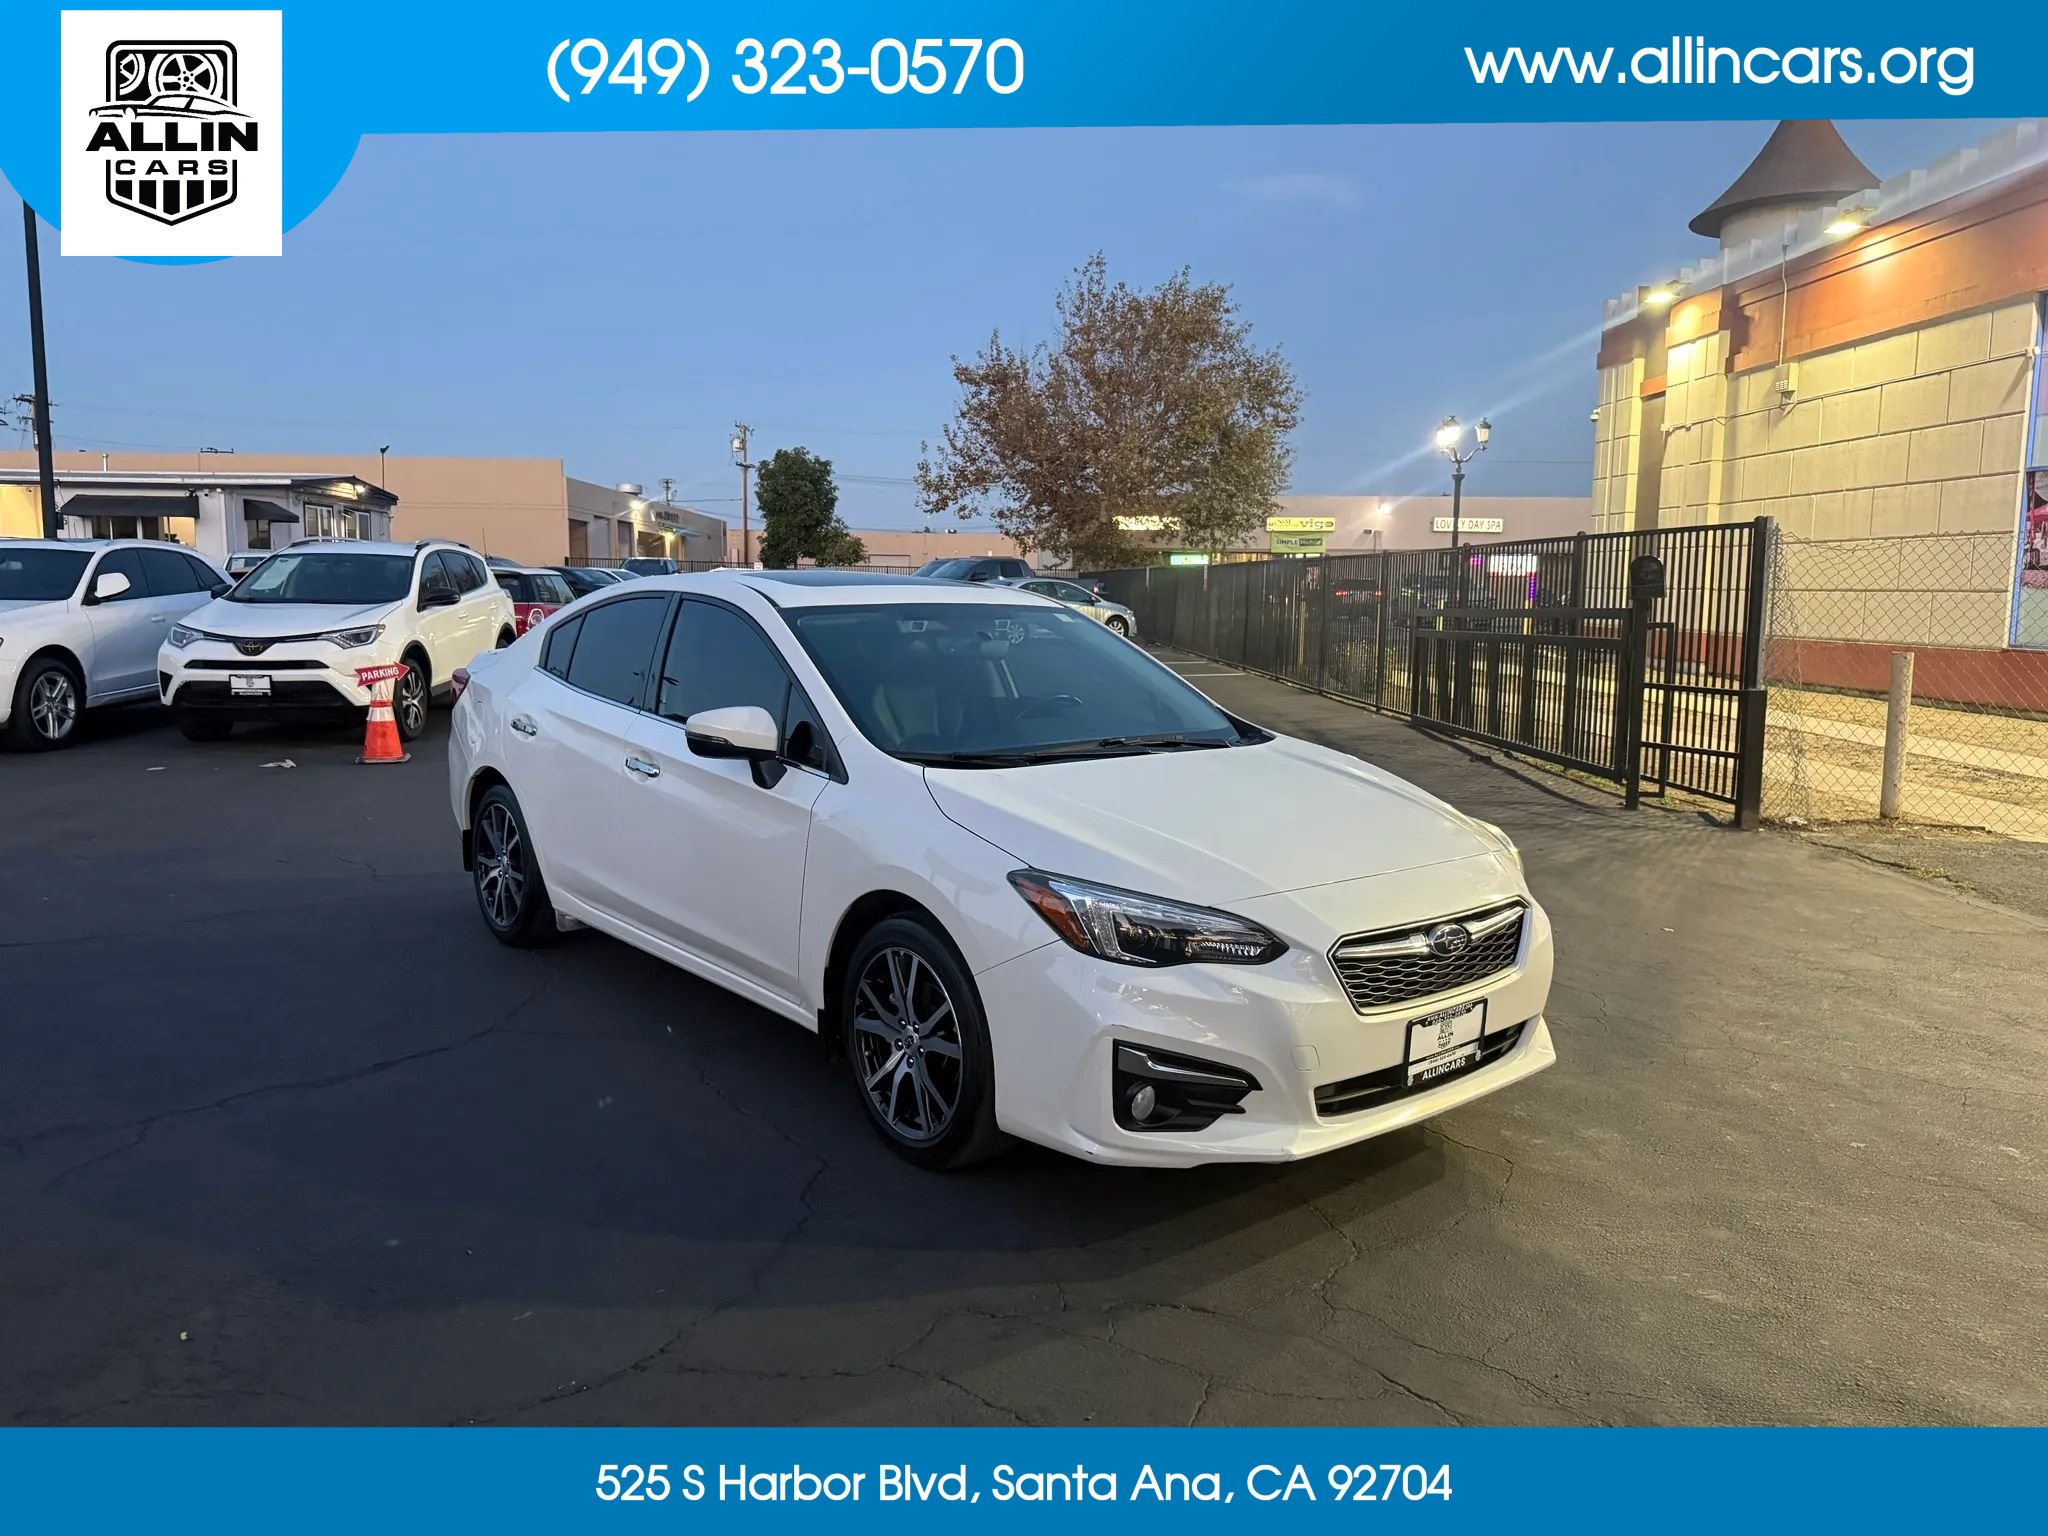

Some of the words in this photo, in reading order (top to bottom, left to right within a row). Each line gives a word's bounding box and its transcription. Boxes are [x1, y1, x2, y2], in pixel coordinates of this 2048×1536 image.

[1468, 520, 1484, 530] DAY
[1487, 520, 1501, 530] SPA
[361, 666, 400, 681] PARKING
[1422, 1056, 1467, 1081] ALLINCARS
